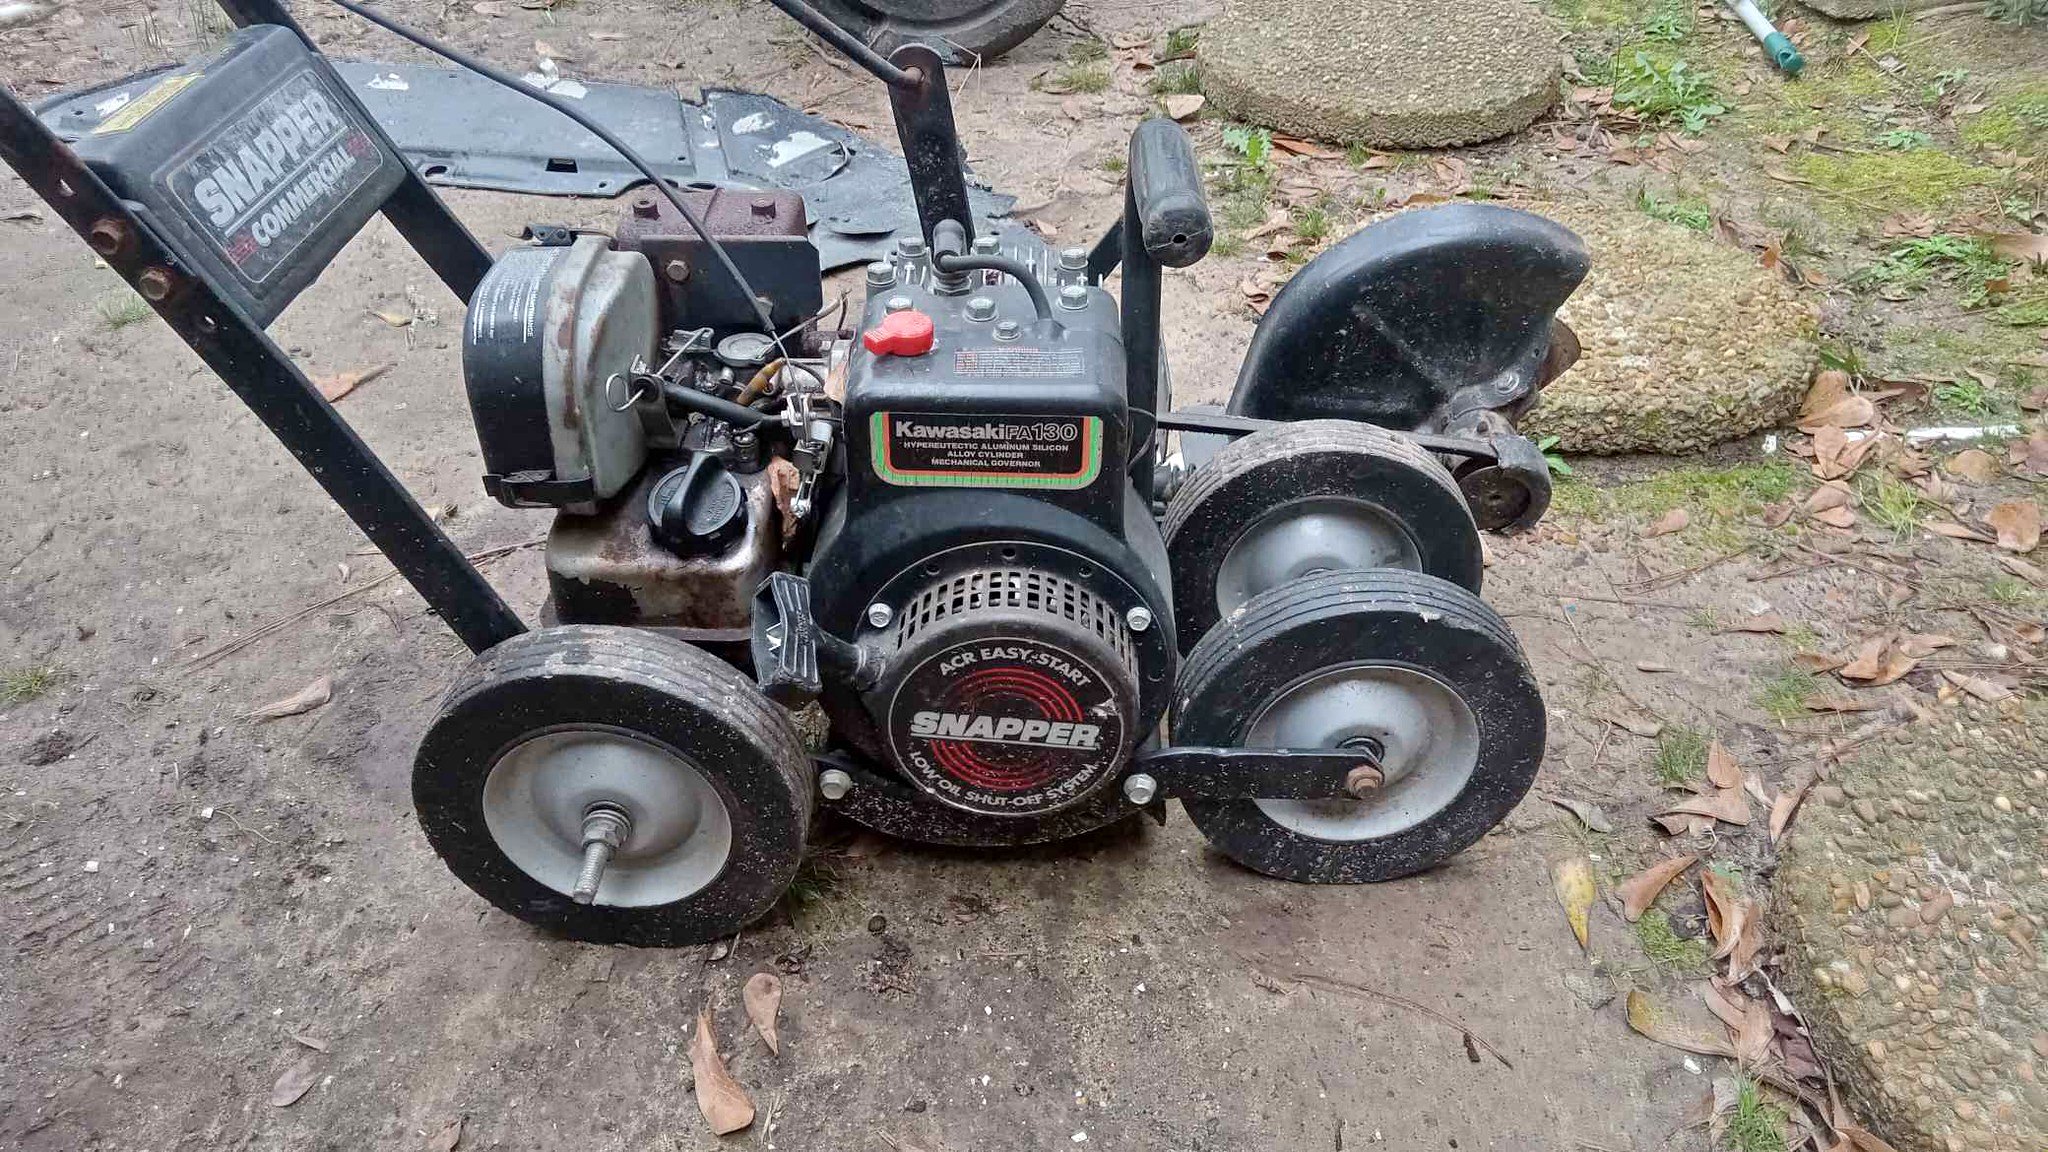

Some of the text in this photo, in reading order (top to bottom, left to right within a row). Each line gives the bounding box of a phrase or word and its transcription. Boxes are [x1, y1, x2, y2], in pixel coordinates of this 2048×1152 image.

[195, 89, 339, 228] SNAPPER
[251, 145, 357, 247] COMMERCIAL
[895, 421, 1079, 442] Kawasaki FA130
[904, 441, 1069, 452] HYPEREUTECTIC ALUMINUM SILICON
[978, 451, 1024, 459] CYLINDER
[931, 458, 1041, 467] MECHANICAL GOVERNOR
[938, 652, 978, 676] ACR
[911, 711, 1101, 747] SNAPPER
[909, 750, 1099, 807] LOW OIL SHUT-OFF SYSTEM
